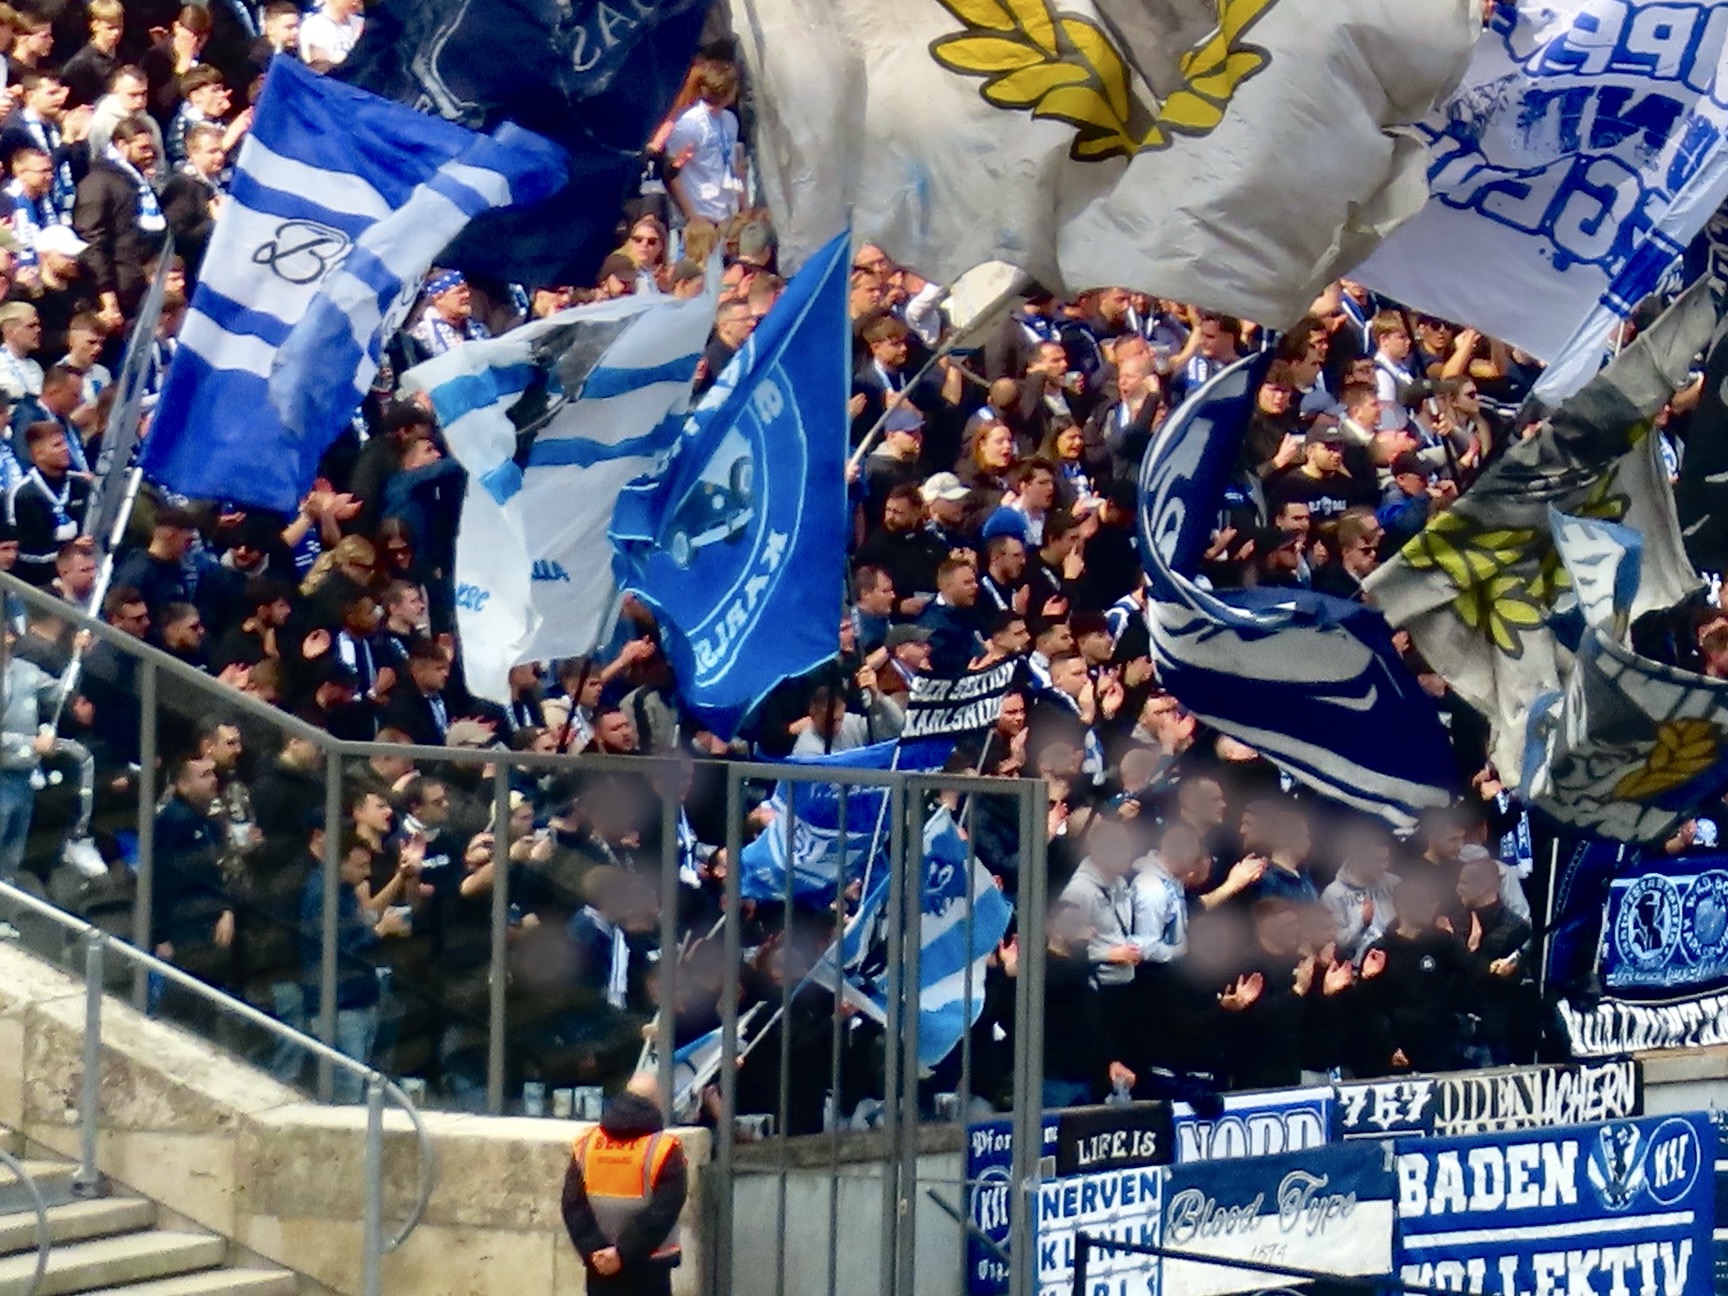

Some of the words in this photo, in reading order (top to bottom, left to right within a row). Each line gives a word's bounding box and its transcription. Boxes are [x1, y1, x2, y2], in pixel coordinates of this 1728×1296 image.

[1079, 1133, 1128, 1165] LIFE
[1131, 1128, 1158, 1157] IS
[1399, 1141, 1577, 1218] BADEN
[1654, 1135, 1689, 1188] KSC
[1042, 1171, 1161, 1221] NERVEN
[1160, 1190, 1266, 1246] Blood
[1277, 1170, 1357, 1240] Type
